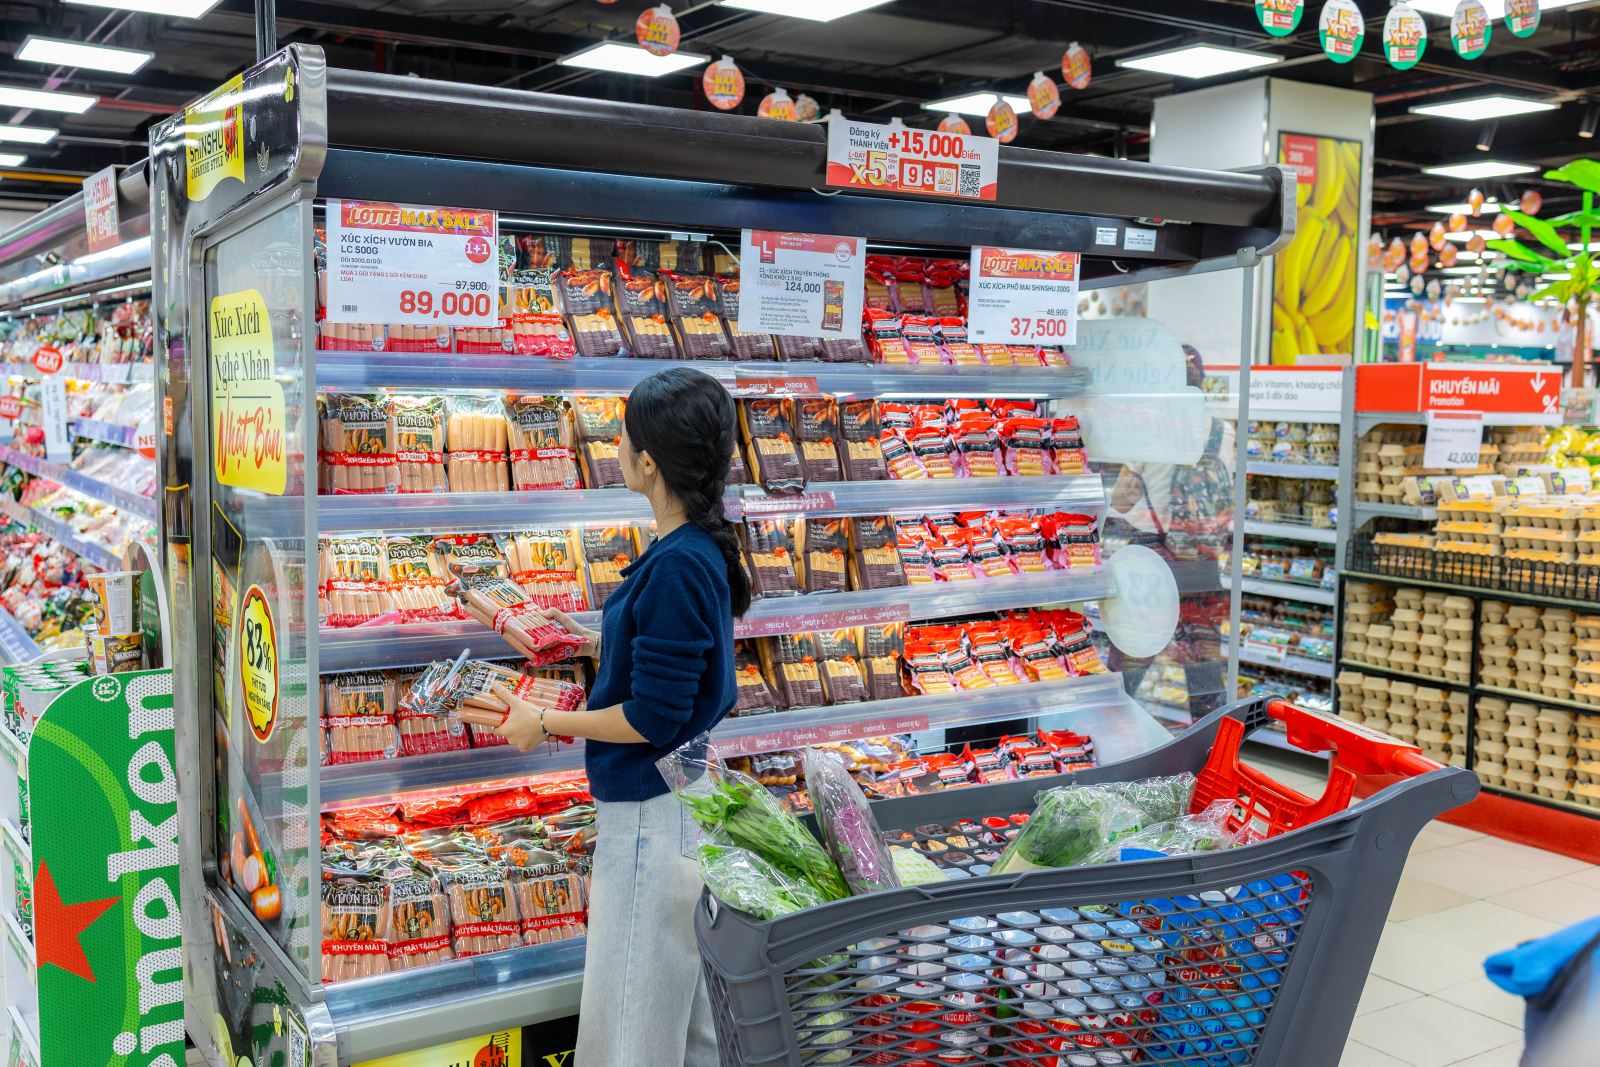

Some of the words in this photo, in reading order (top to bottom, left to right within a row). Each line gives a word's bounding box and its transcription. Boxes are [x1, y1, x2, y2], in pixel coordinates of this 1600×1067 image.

[870, 127, 880, 140] ký
[888, 130, 964, 159] +15,000
[908, 166, 918, 183] 9
[938, 170, 954, 186] 19
[350, 207, 401, 226] LOTTE
[401, 209, 440, 227] MAX
[341, 233, 361, 244] XÚC
[364, 234, 386, 246] XÍCH
[388, 236, 416, 247] VƯỜN
[418, 238, 434, 248] BIA
[763, 240, 772, 254] L
[341, 246, 353, 254] LC
[355, 246, 378, 255] 500G
[465, 242, 488, 256] 1+1
[982, 256, 1018, 272] LOTTE
[1018, 258, 1043, 272] MAX
[1045, 258, 1073, 272] SALE
[455, 281, 487, 291] 97,900
[785, 281, 820, 294] 124,000
[992, 280, 1006, 290] XÍCH
[1032, 284, 1056, 292] SHINSHU
[400, 290, 490, 318] 89,000
[214, 307, 232, 338] Xúc
[235, 301, 260, 334] Xích
[1010, 318, 1067, 339] 37,500
[215, 352, 240, 391] Nghệ
[241, 349, 270, 381] Nhân
[1430, 376, 1476, 396] KHUYẾN
[1478, 380, 1500, 395] MÃI
[254, 406, 282, 470] Bản
[1448, 452, 1477, 464] 42,000
[246, 618, 272, 674] 83%
[896, 720, 914, 728] CHOICE
[332, 894, 360, 904] VƯỜN
[332, 942, 364, 952] KHUYẾN
[365, 942, 380, 951] MÃI
